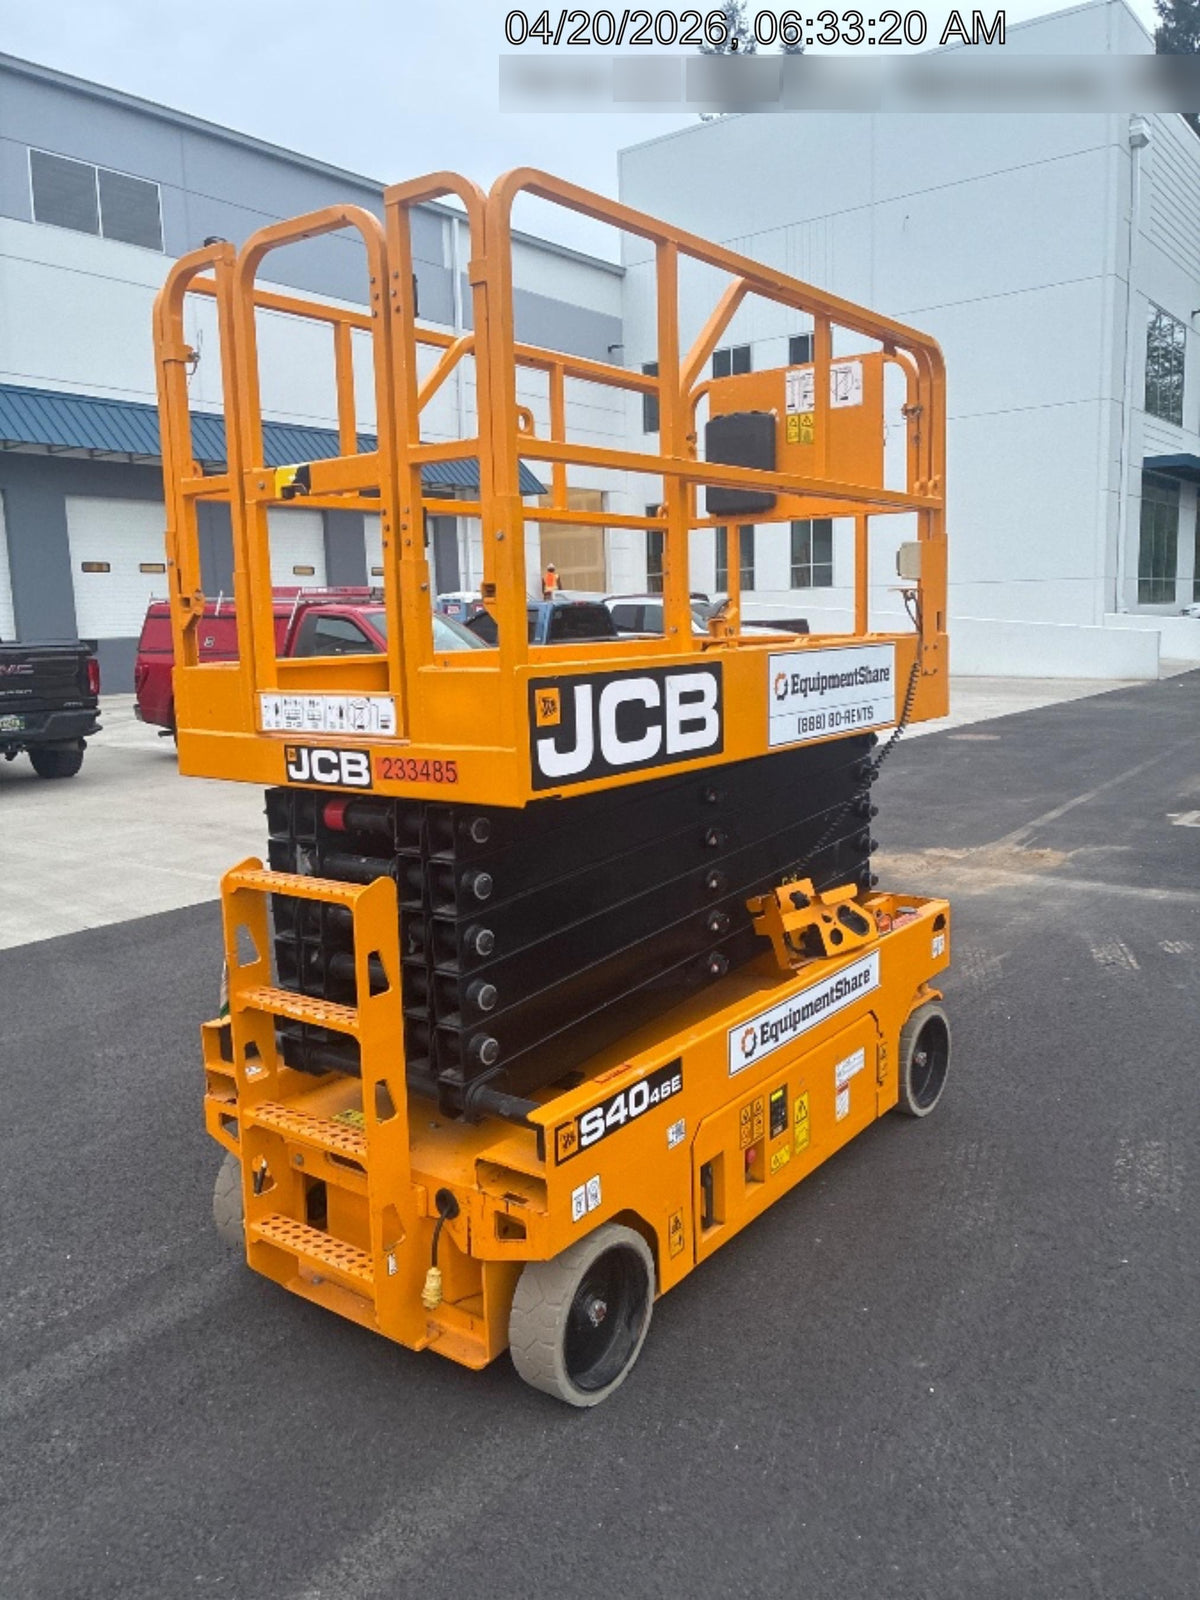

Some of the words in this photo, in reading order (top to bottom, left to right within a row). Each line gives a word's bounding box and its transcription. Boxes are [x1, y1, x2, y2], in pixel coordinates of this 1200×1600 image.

[791, 665, 890, 697] EquipmentShare
[536, 671, 719, 777] JCB
[828, 705, 875, 728] 80-RENTS
[287, 748, 371, 786] JCB
[382, 756, 459, 784] 233485
[759, 969, 870, 1045] EquipmentShare
